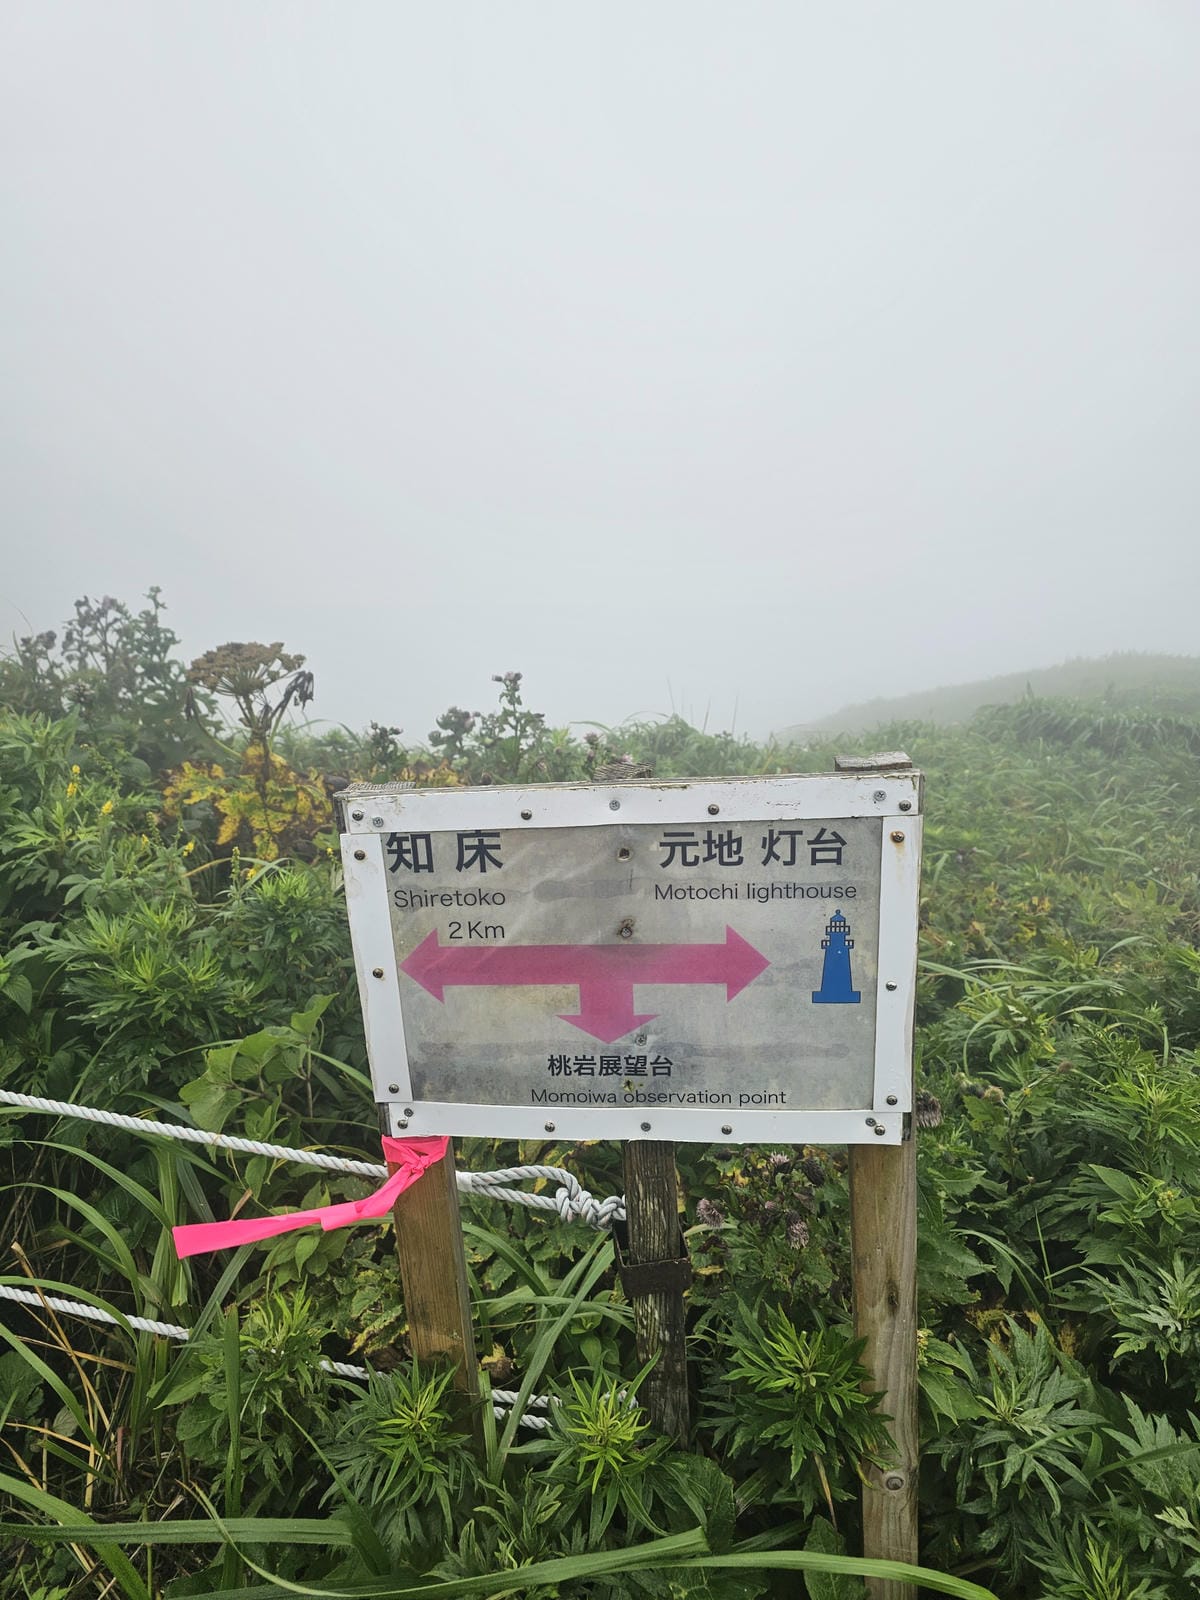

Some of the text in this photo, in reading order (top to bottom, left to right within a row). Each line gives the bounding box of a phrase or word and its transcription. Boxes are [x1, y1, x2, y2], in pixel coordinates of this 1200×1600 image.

[385, 829, 503, 873] 知床
[394, 888, 506, 908] Shiretoko
[655, 882, 857, 903] Motochi lighthouse
[548, 1054, 673, 1076] 桃岩展望台
[531, 1088, 787, 1107] Momoiwa observation point
